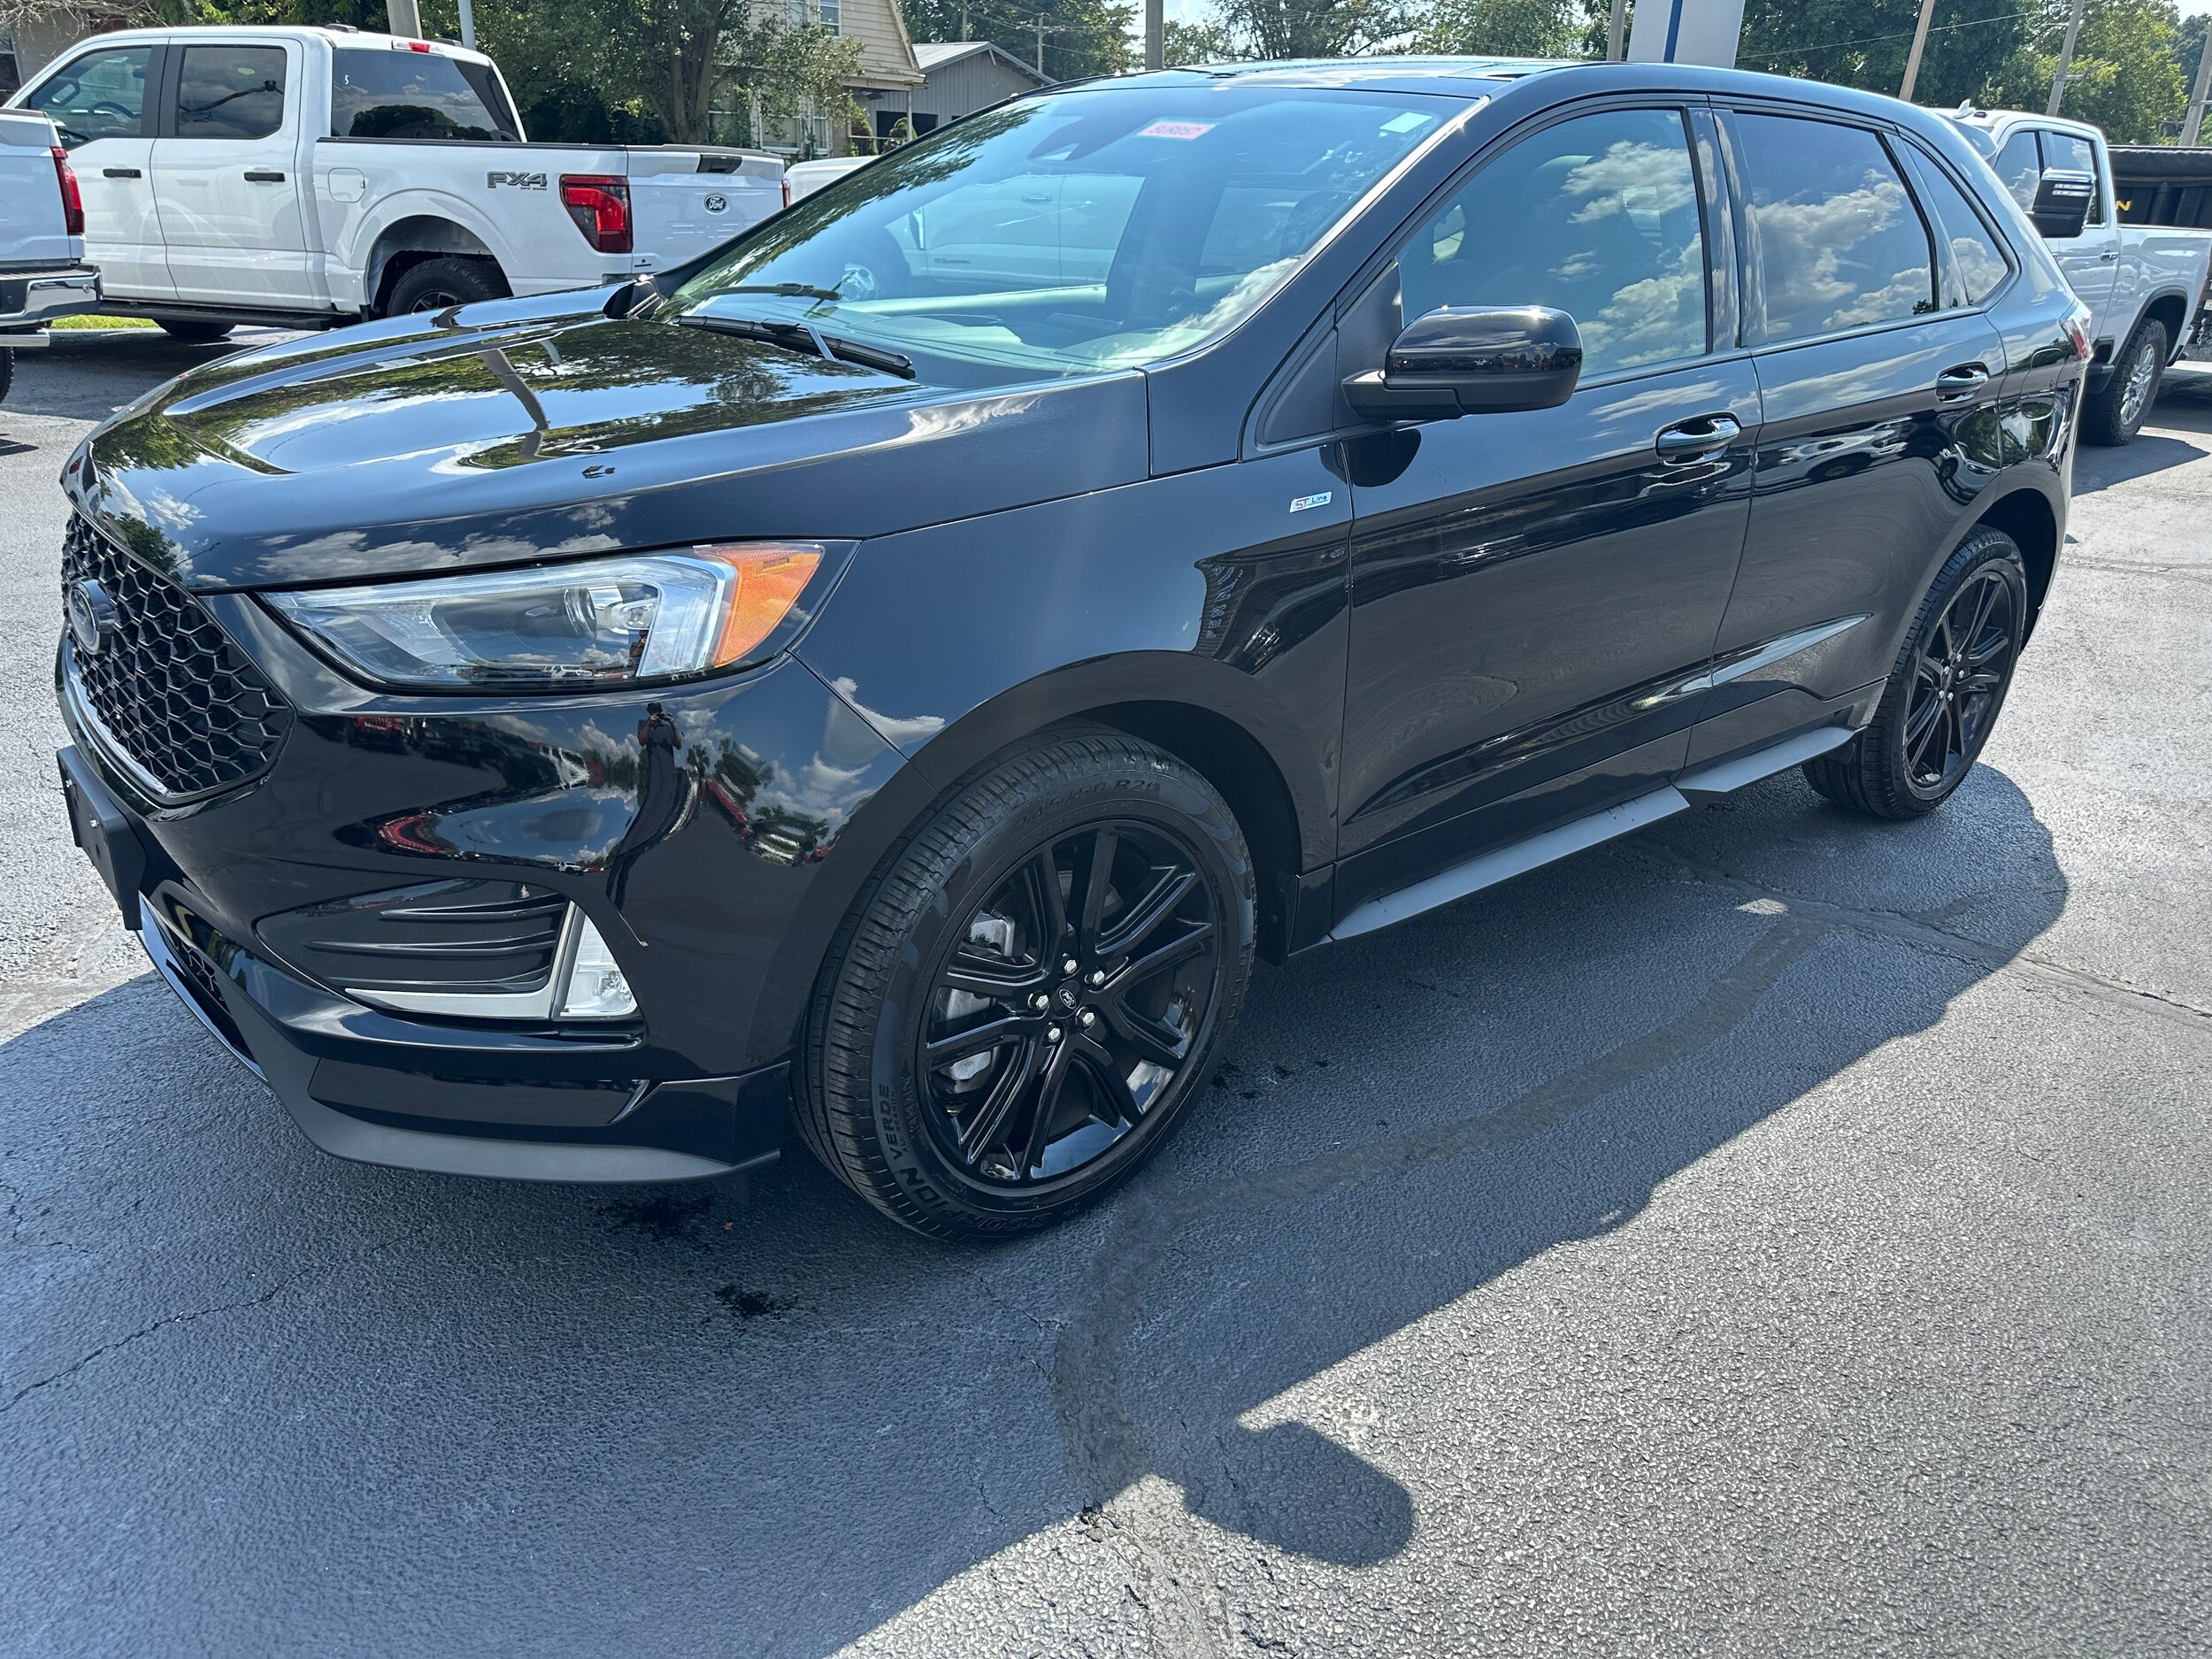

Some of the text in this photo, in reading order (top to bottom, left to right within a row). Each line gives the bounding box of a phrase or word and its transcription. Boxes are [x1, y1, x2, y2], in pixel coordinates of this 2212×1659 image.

[487, 171, 548, 188] FX4
[708, 196, 724, 210] Ford
[1295, 497, 1310, 510] ST
[1114, 779, 1161, 793] R20
[879, 1083, 903, 1161] VERDE
